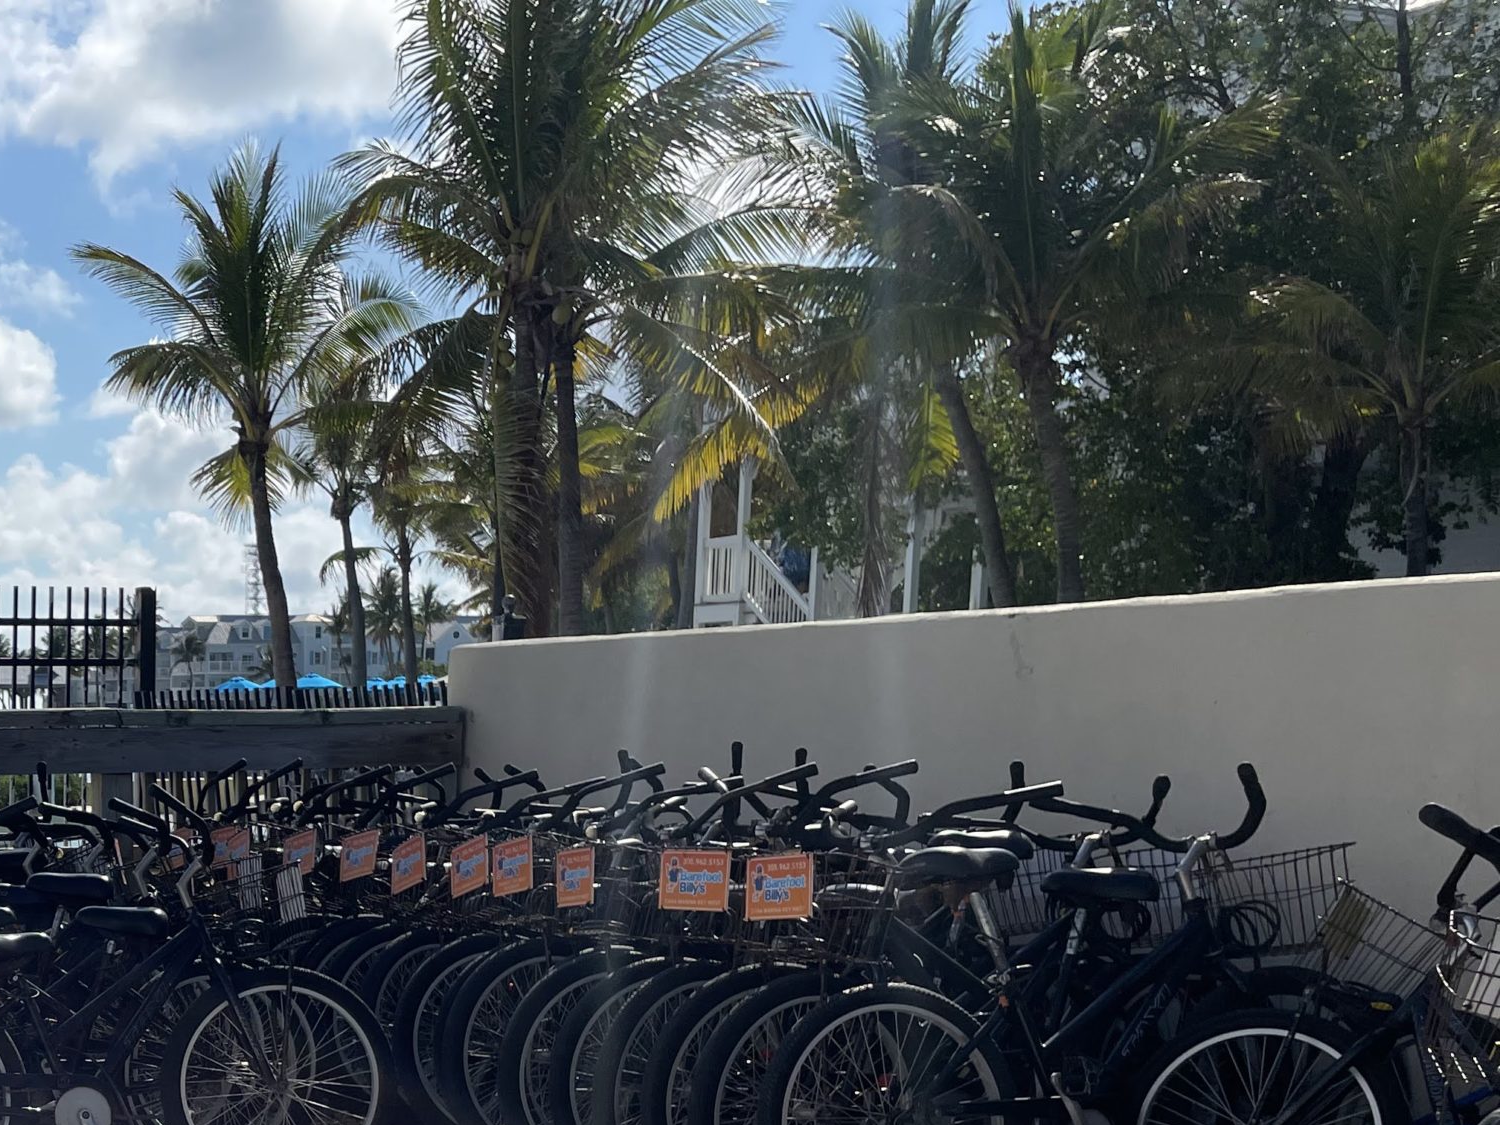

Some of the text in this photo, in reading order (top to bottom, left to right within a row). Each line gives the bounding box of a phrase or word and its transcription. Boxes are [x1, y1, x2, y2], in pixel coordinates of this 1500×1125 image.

[679, 870, 723, 883] Barefoot
[764, 875, 805, 889] Barefoot
[679, 881, 706, 896] Billy's
[764, 889, 790, 904] Billy's
